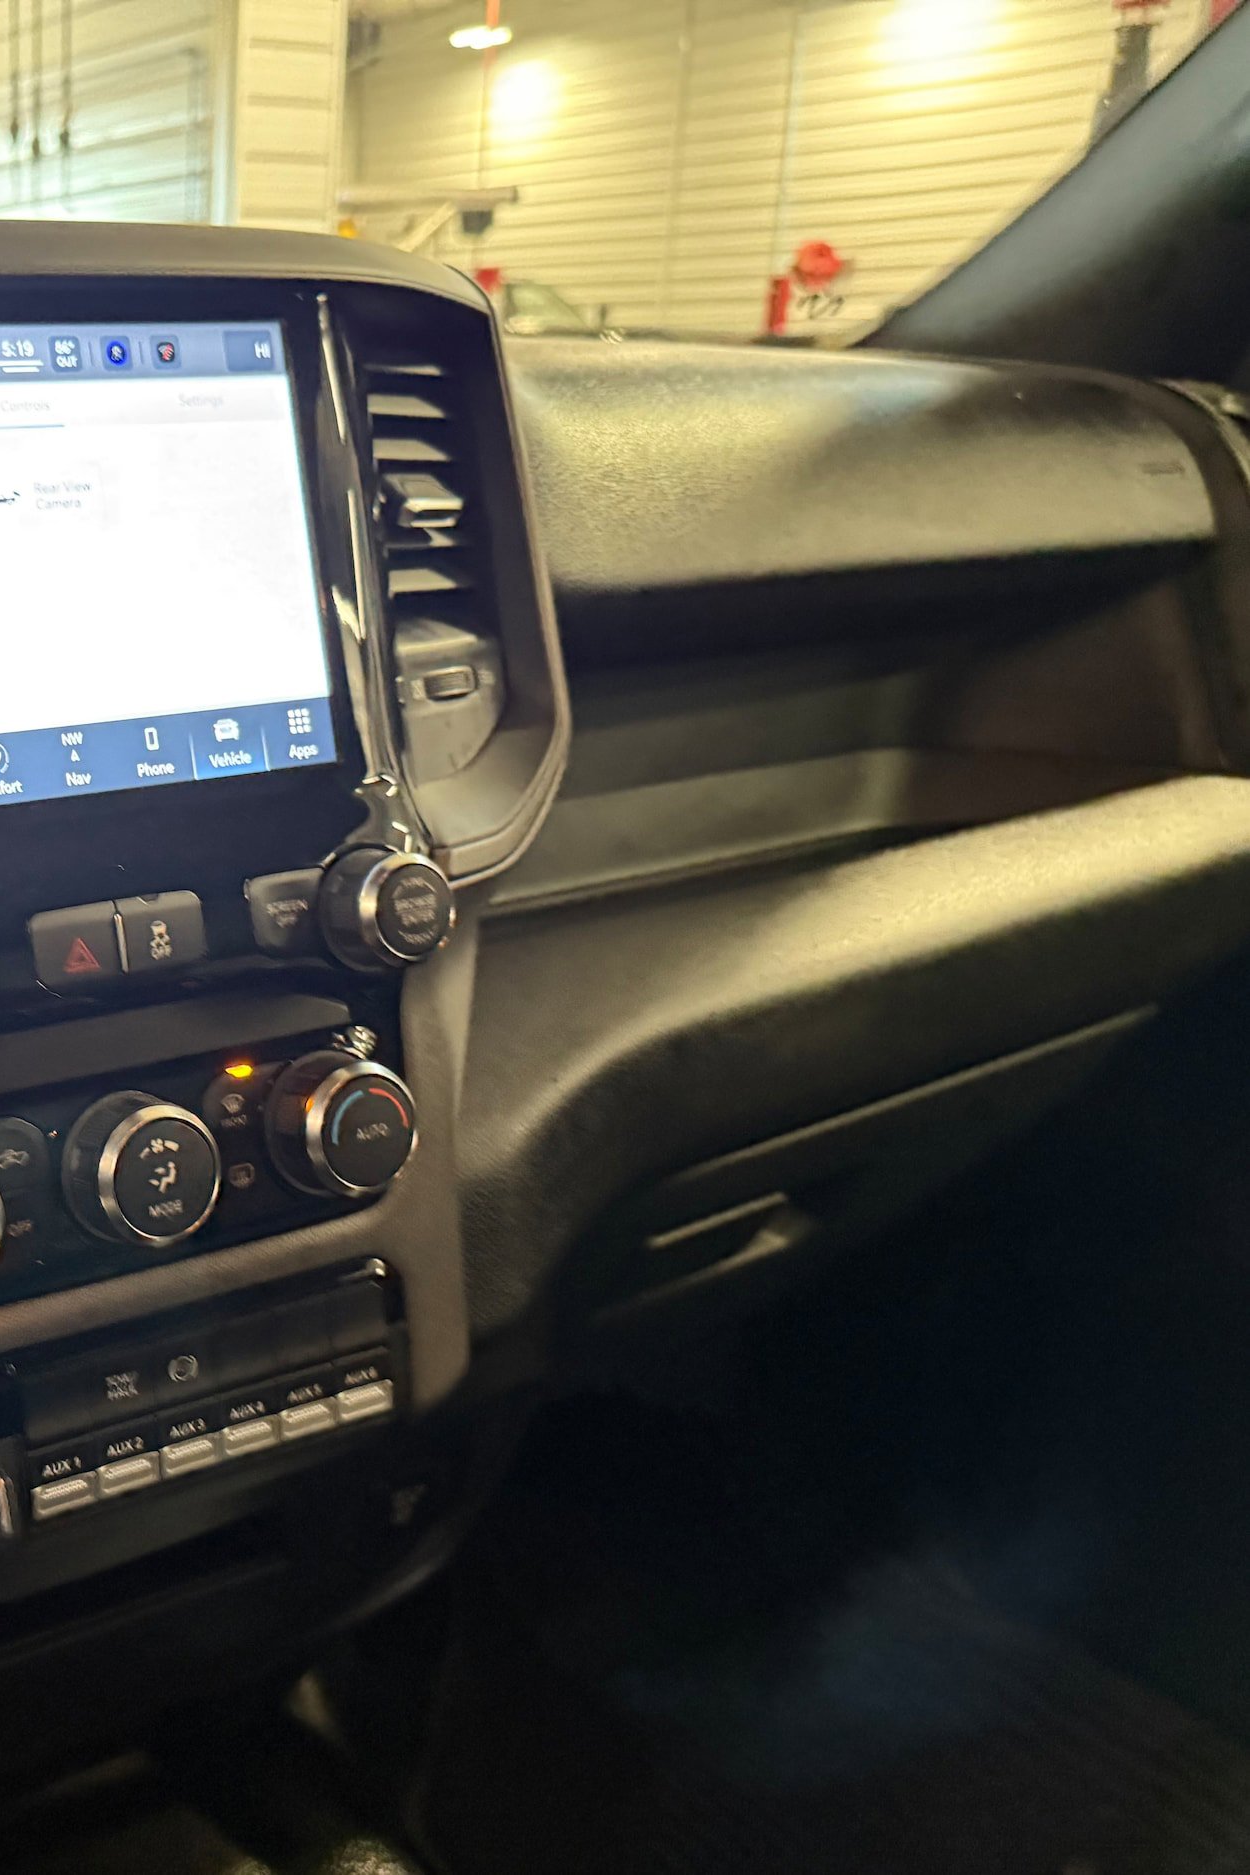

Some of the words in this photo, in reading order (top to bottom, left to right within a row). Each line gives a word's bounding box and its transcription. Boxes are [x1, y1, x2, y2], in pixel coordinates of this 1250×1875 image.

[2, 339, 35, 357] 5:19
[56, 355, 79, 368] OUT
[0, 399, 50, 413] Controls
[178, 393, 224, 409] Settings
[34, 482, 60, 494] Rear
[63, 480, 92, 493] View
[36, 498, 82, 511] Camera
[61, 732, 84, 747] NW
[208, 749, 252, 768] Vehicle
[288, 742, 318, 761] Apps
[136, 760, 175, 778] Phone
[65, 771, 92, 788] Nav
